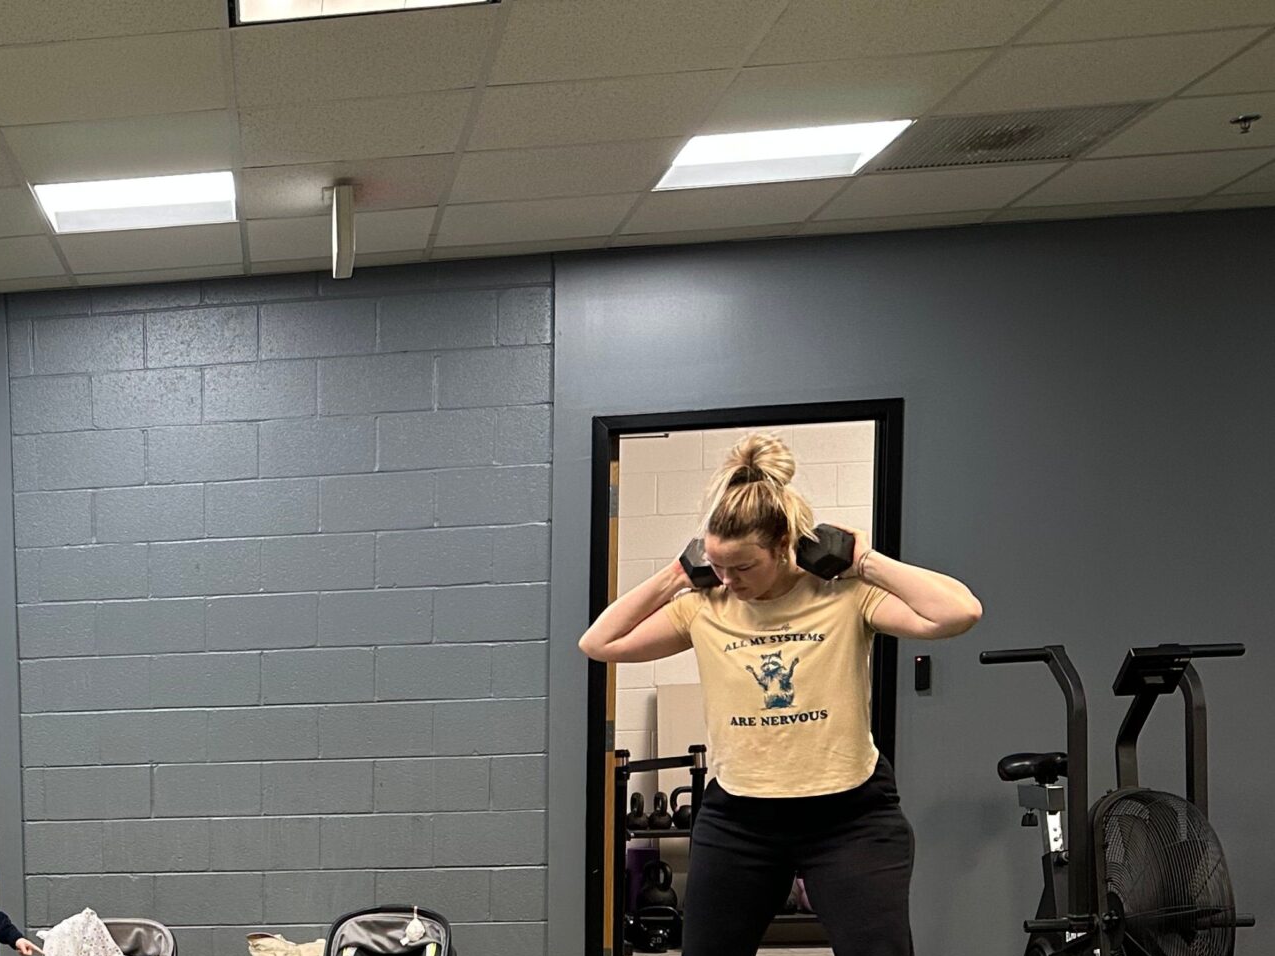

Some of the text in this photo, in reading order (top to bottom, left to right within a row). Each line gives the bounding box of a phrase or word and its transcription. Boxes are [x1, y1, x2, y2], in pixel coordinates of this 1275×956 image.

[724, 633, 826, 653] ALL MY SYSTEMS
[730, 709, 829, 726] ARE NERVOUS
